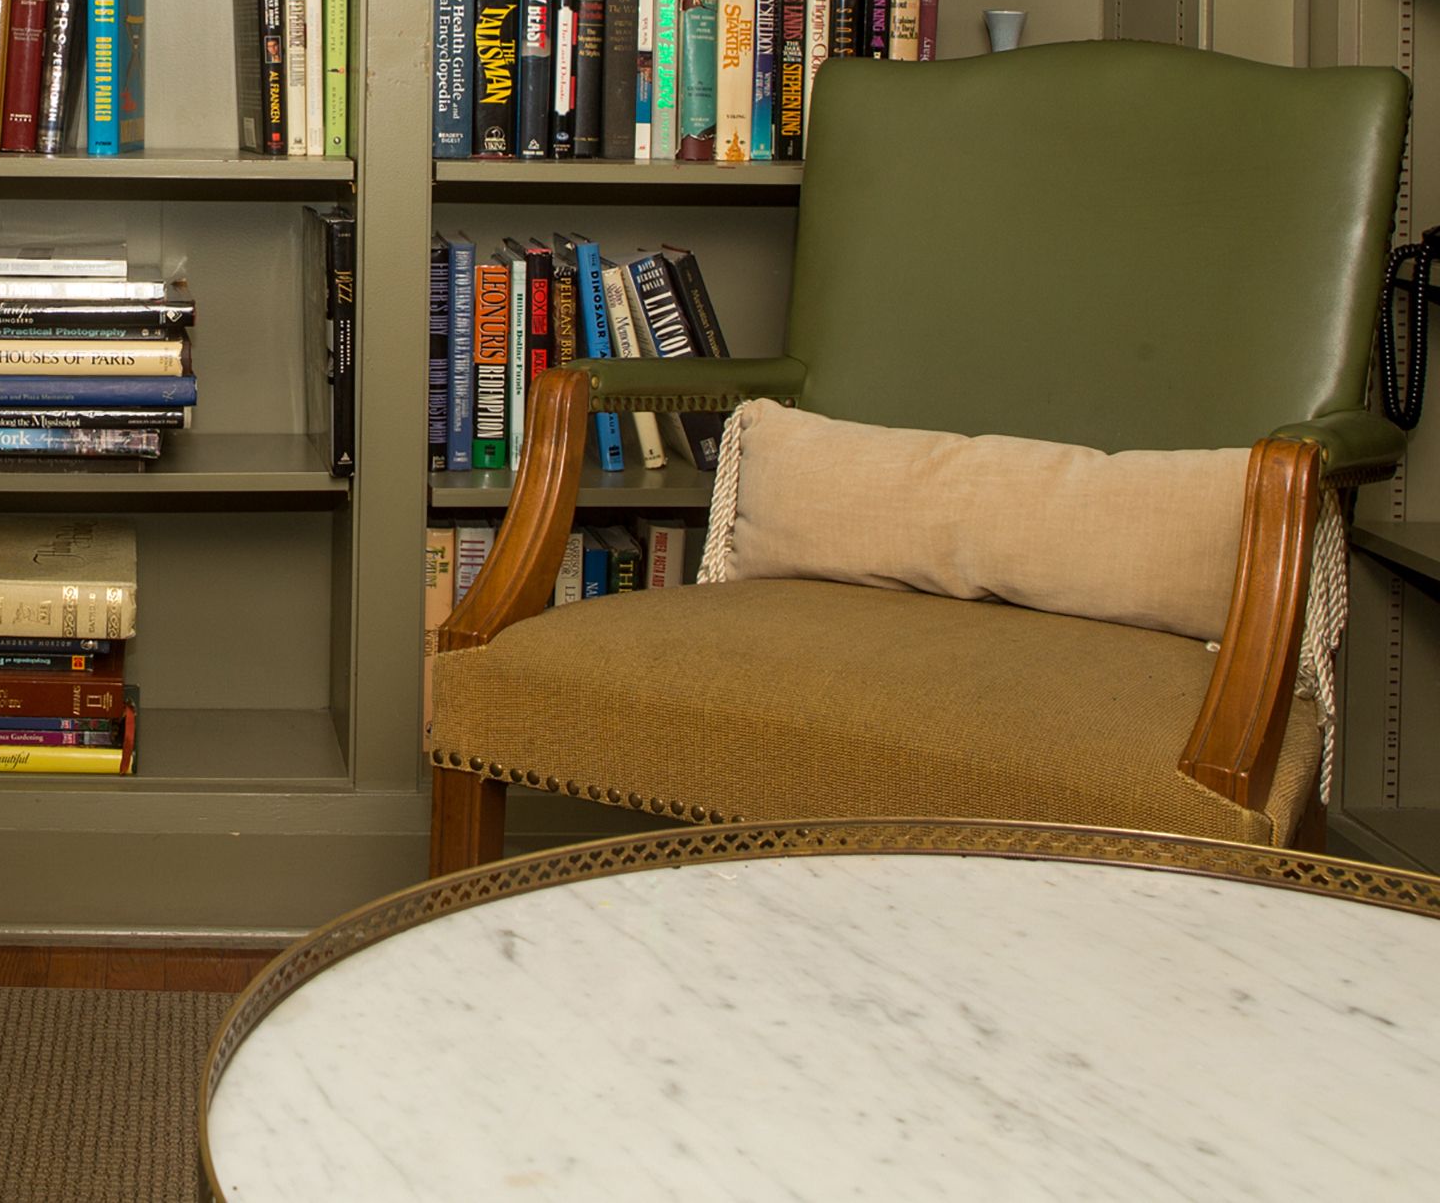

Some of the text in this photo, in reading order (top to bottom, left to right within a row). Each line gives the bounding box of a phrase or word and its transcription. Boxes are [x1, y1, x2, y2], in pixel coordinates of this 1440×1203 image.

[453, 5, 466, 53] Health
[526, 5, 546, 49] BEAST
[658, 29, 675, 43] A
[723, 4, 741, 70] STARTER
[758, 8, 774, 55] SHELDON
[783, 5, 803, 40] LANDS
[872, 8, 886, 32] KING
[437, 15, 450, 113] Encyclopedia
[475, 4, 518, 105] TALISMAN
[500, 39, 516, 65] THE
[657, 43, 674, 65] ME
[269, 70, 280, 124] AL FRANKEN
[453, 56, 466, 100] Guide
[657, 67, 675, 110] PAINT
[781, 63, 802, 136] STEPHEN KING
[452, 103, 460, 120] and
[334, 270, 353, 304] JAZZ
[533, 280, 546, 313] BOX
[637, 267, 664, 284] HERBERT
[479, 270, 507, 360] LEON URIS
[590, 270, 608, 339] DINOSAUR
[63, 351, 87, 365] OF
[91, 352, 135, 366] PARIS
[17, 417, 30, 427] the
[31, 415, 81, 429] Mississippi
[477, 365, 505, 439] REDEMPTION
[10, 734, 44, 742] Gardening
